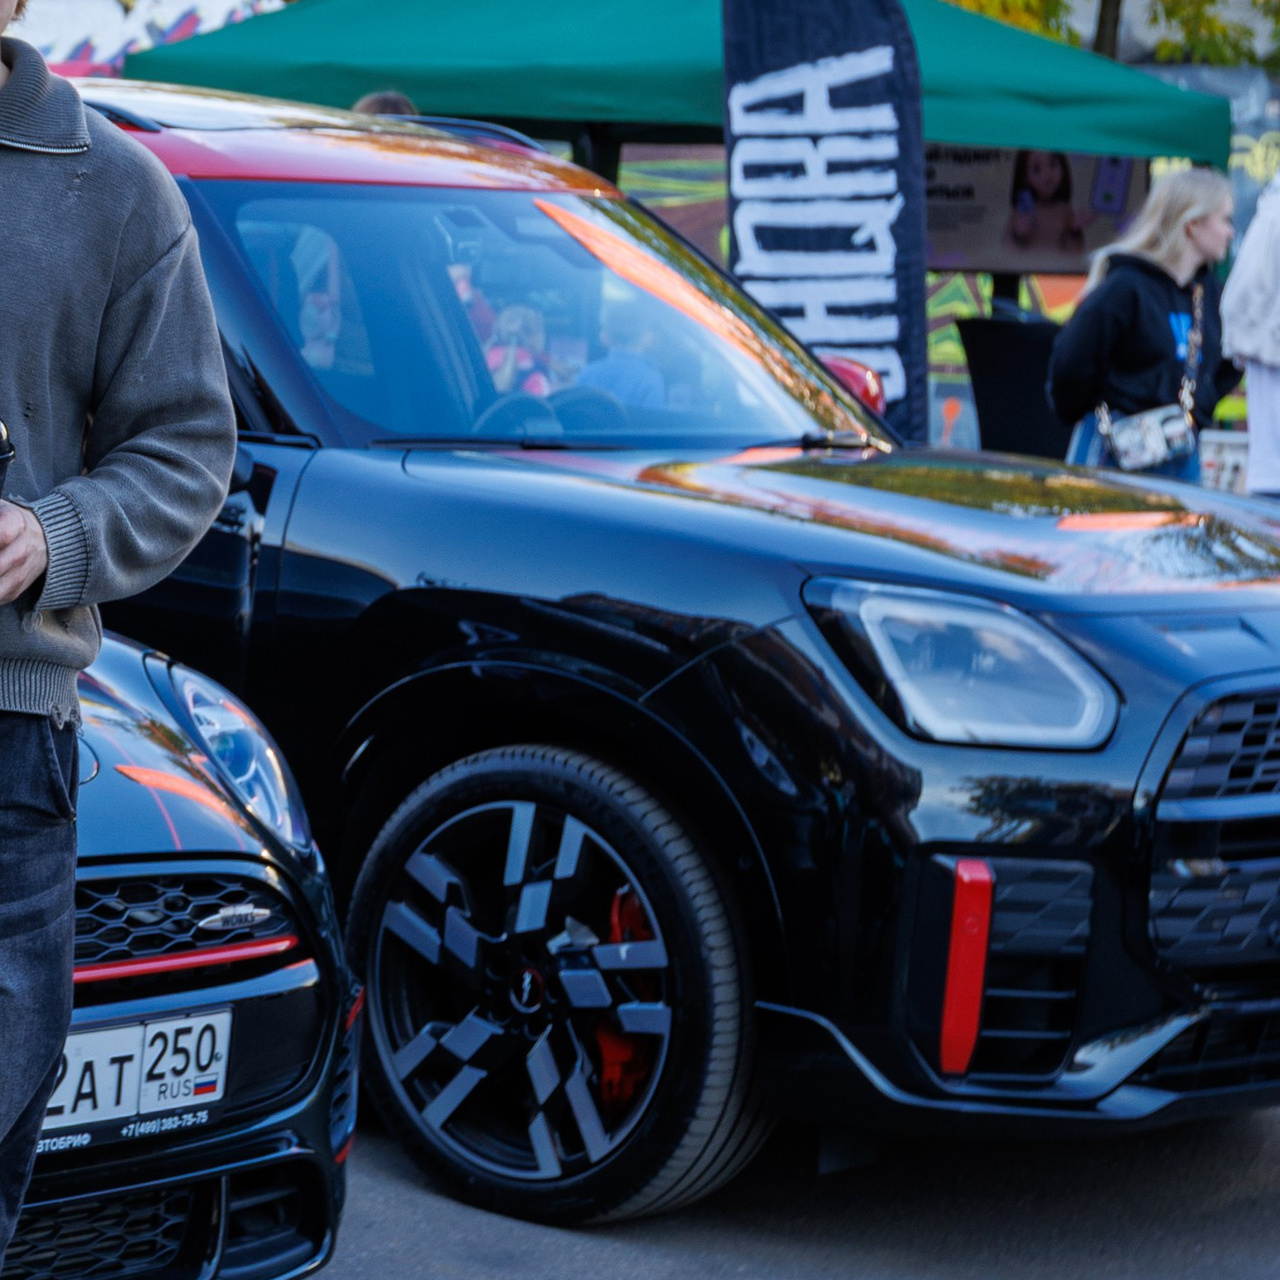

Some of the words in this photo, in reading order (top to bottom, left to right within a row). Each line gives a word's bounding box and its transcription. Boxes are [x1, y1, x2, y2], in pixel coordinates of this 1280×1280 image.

[728, 45, 906, 402] HQRA
[221, 913, 256, 927] WORKS
[145, 1023, 217, 1082] 250
[157, 1078, 192, 1102] RUS
[36, 1133, 91, 1153] ВТОБРИФ
